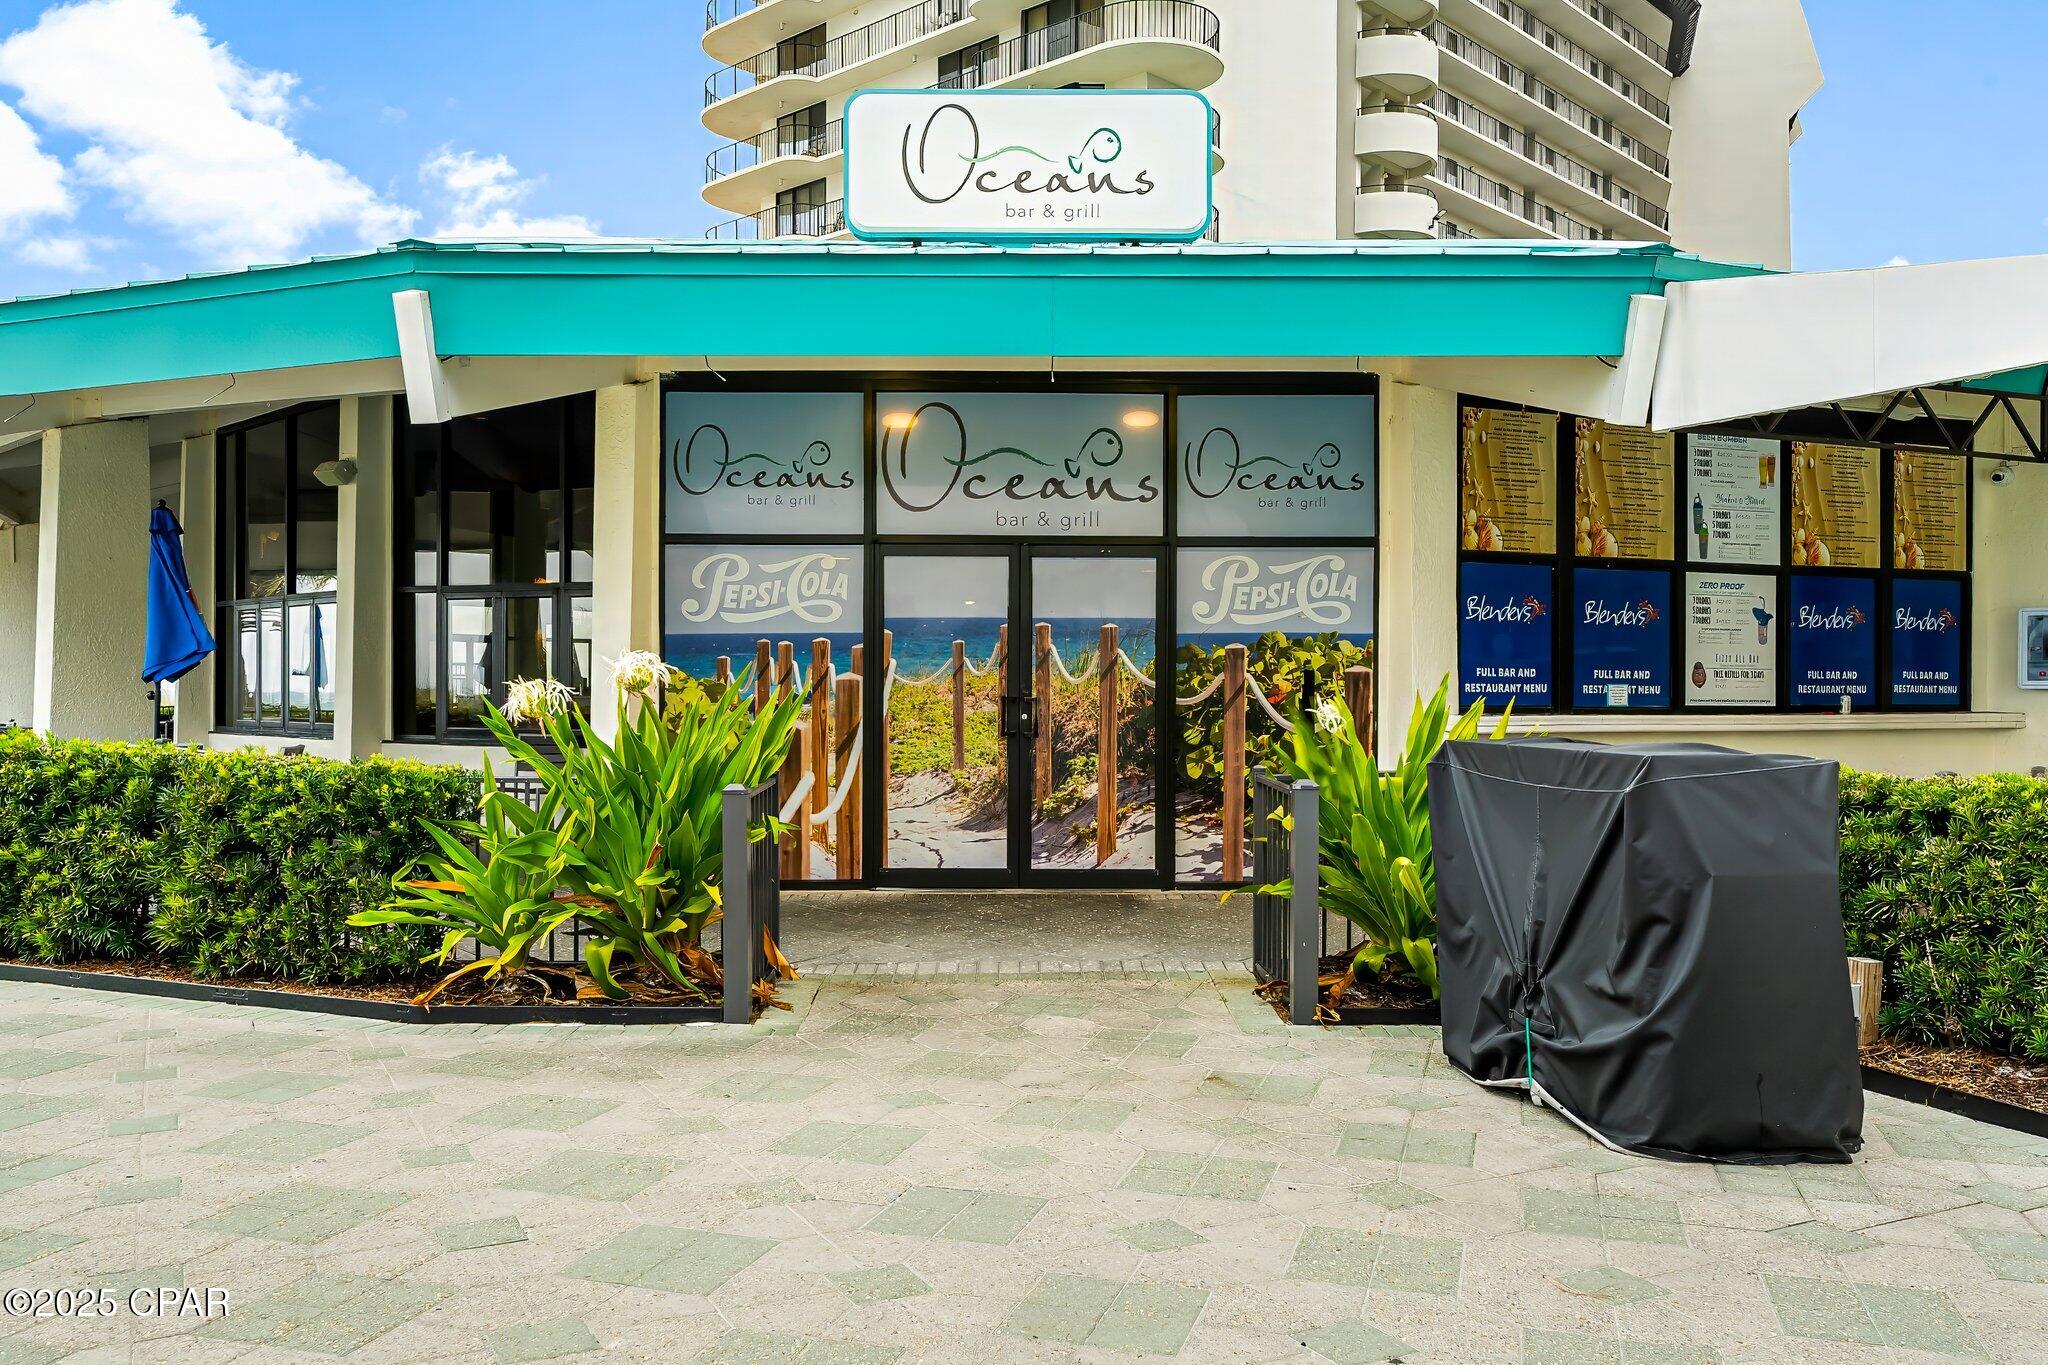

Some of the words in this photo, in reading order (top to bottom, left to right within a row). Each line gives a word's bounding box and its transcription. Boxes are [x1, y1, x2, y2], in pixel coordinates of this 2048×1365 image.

[902, 104, 1154, 203] Oceans
[1005, 204, 1035, 218] bar
[1043, 204, 1056, 219] &
[1064, 203, 1100, 222] grill
[673, 424, 854, 495] Oceans
[881, 402, 1159, 512] Oceans
[1184, 427, 1365, 498] Oceans
[747, 494, 768, 506] bar
[775, 495, 784, 506] &
[789, 494, 816, 508] grill
[1258, 497, 1279, 508] bar
[1285, 497, 1295, 508] &
[1300, 497, 1327, 510] grill
[996, 511, 1027, 527] bar
[1037, 511, 1050, 527] &
[1060, 511, 1100, 531] grill
[1465, 595, 1532, 622] Blenders
[1584, 600, 1646, 627] Blenders
[1798, 605, 1854, 631] Blenders
[1894, 607, 1947, 633] Blenders
[1476, 668, 1497, 677] FULL
[1499, 668, 1516, 677] BAR
[1517, 668, 1536, 678] AND
[1593, 669, 1613, 679] FULL
[1614, 669, 1631, 679] BAR
[1633, 670, 1650, 680] AND
[1807, 670, 1824, 679] FULL
[1826, 670, 1841, 679] BAR
[1842, 671, 1858, 680] AND
[1902, 670, 1918, 680] FULL
[1919, 671, 1934, 680] BAR
[1935, 671, 1949, 680] AND
[1465, 683, 1522, 693] RESTAURANT
[1523, 683, 1548, 693] MENU
[1638, 685, 1661, 695] MENU
[1798, 685, 1846, 694] RESTAURANT
[1847, 685, 1867, 694] MENU
[1893, 684, 1937, 694] RESTAURANT
[1938, 685, 1958, 694] MENU
